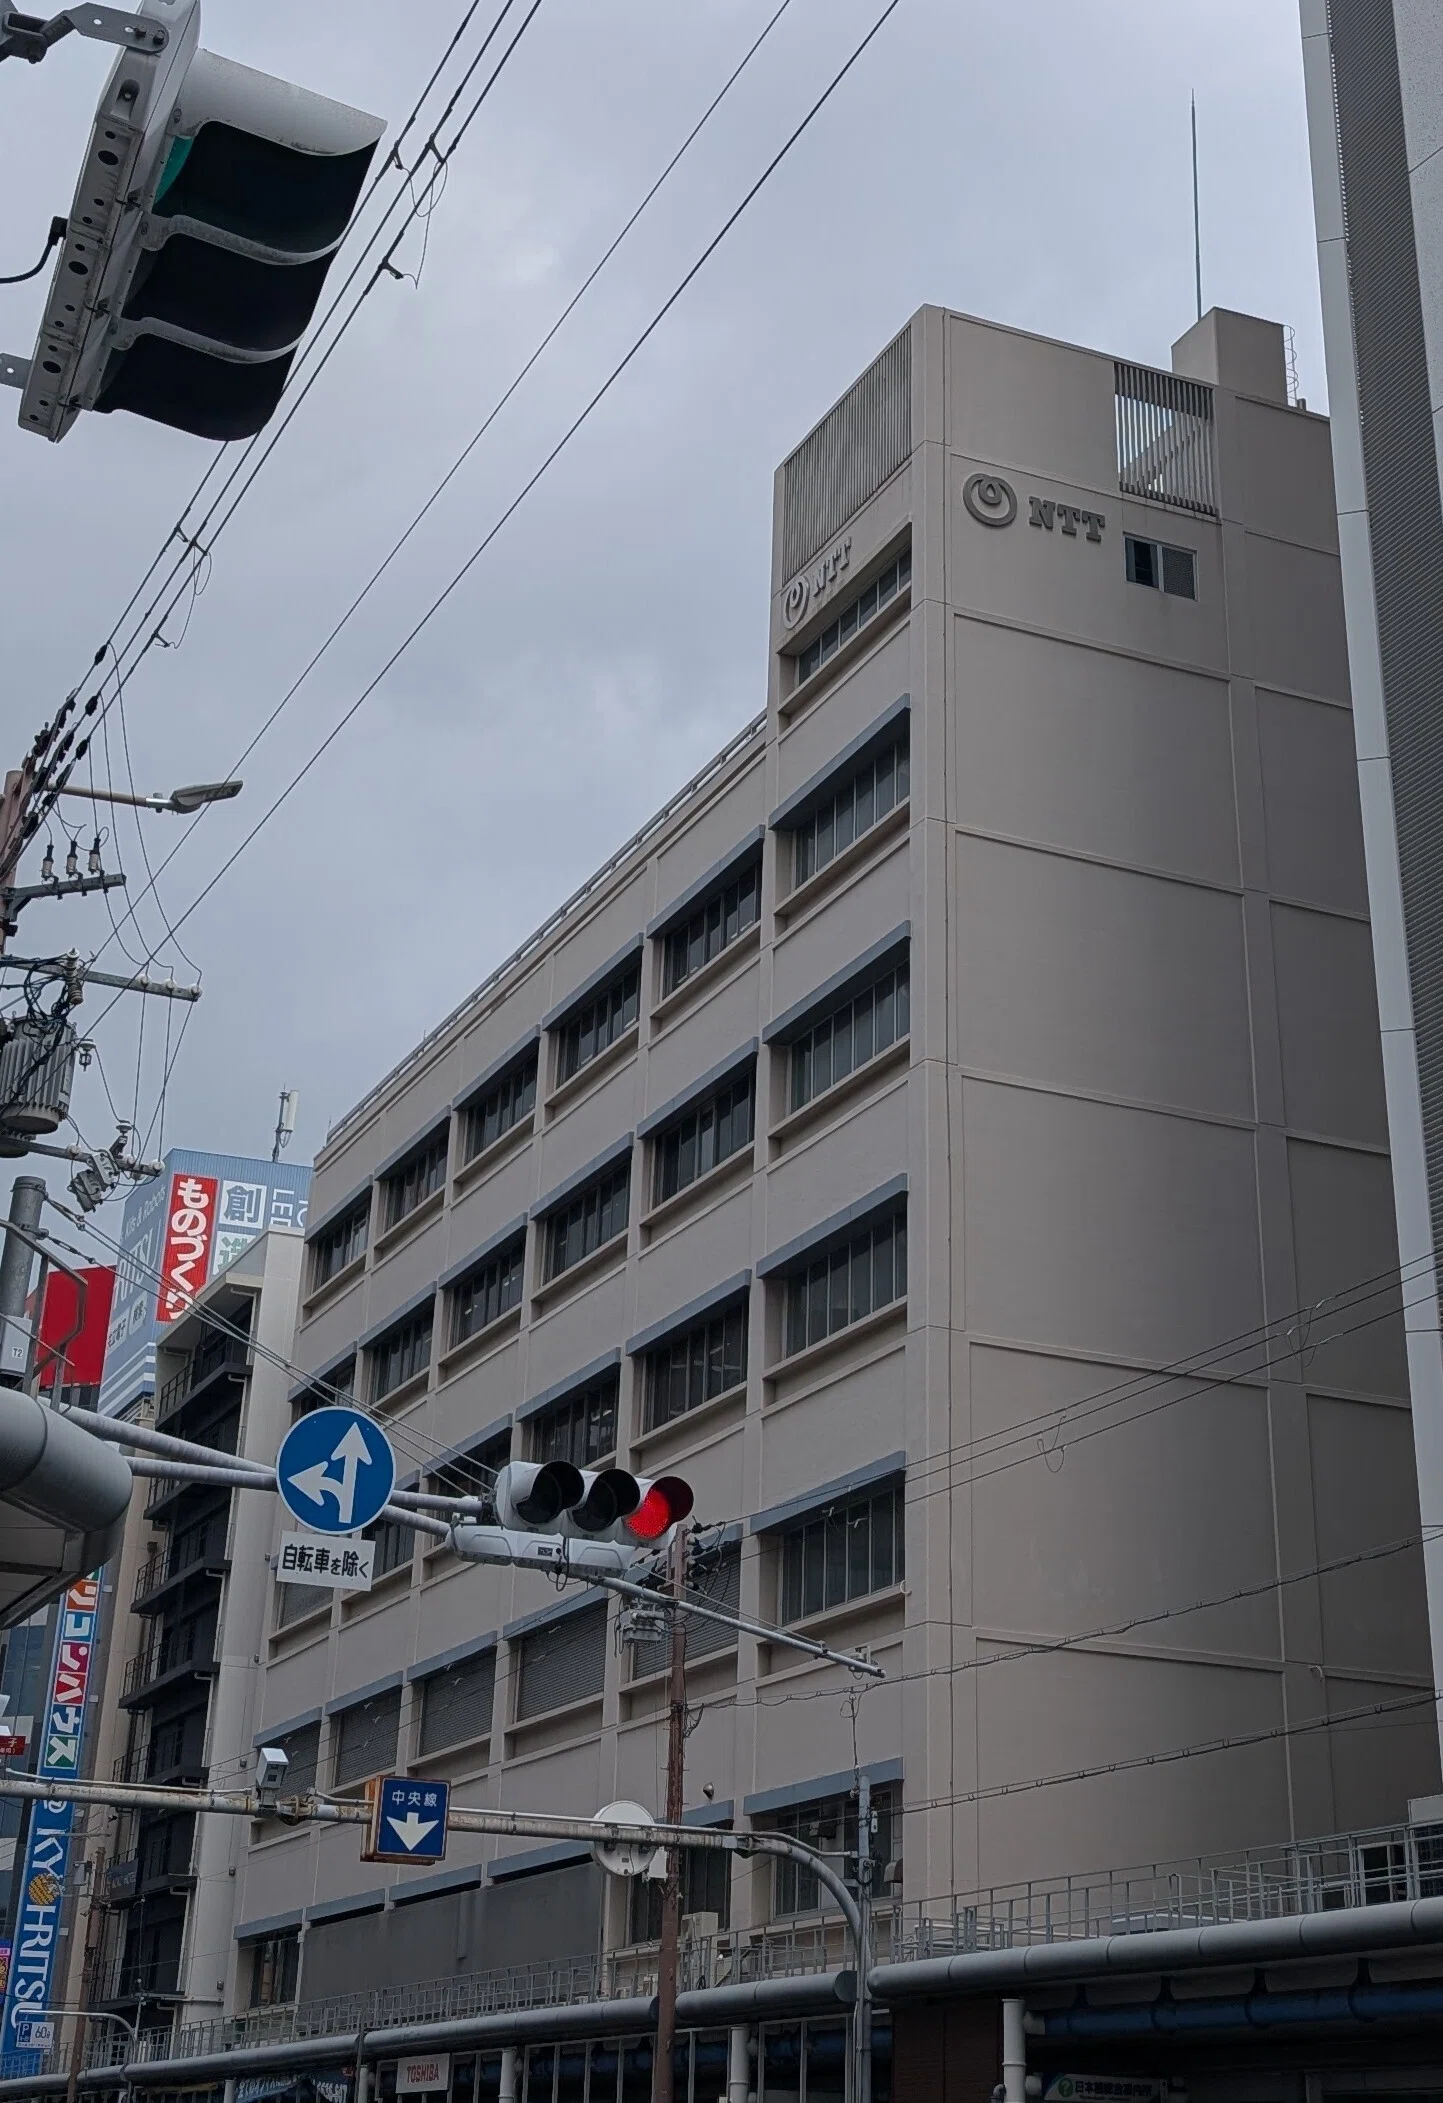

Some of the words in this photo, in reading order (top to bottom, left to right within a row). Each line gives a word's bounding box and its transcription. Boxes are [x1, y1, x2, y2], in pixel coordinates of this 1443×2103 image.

[1028, 495, 1105, 541] NTT
[812, 537, 852, 596] NTT
[165, 1178, 209, 1319] ものづくり
[13, 1347, 22, 1357] T2
[282, 1543, 370, 1579] 自転車を除く
[48, 1572, 97, 1765] リコンハウス
[391, 1788, 438, 1808] 中央線
[21, 2023, 29, 2036] P
[406, 2063, 440, 2083] TOSHIBA
